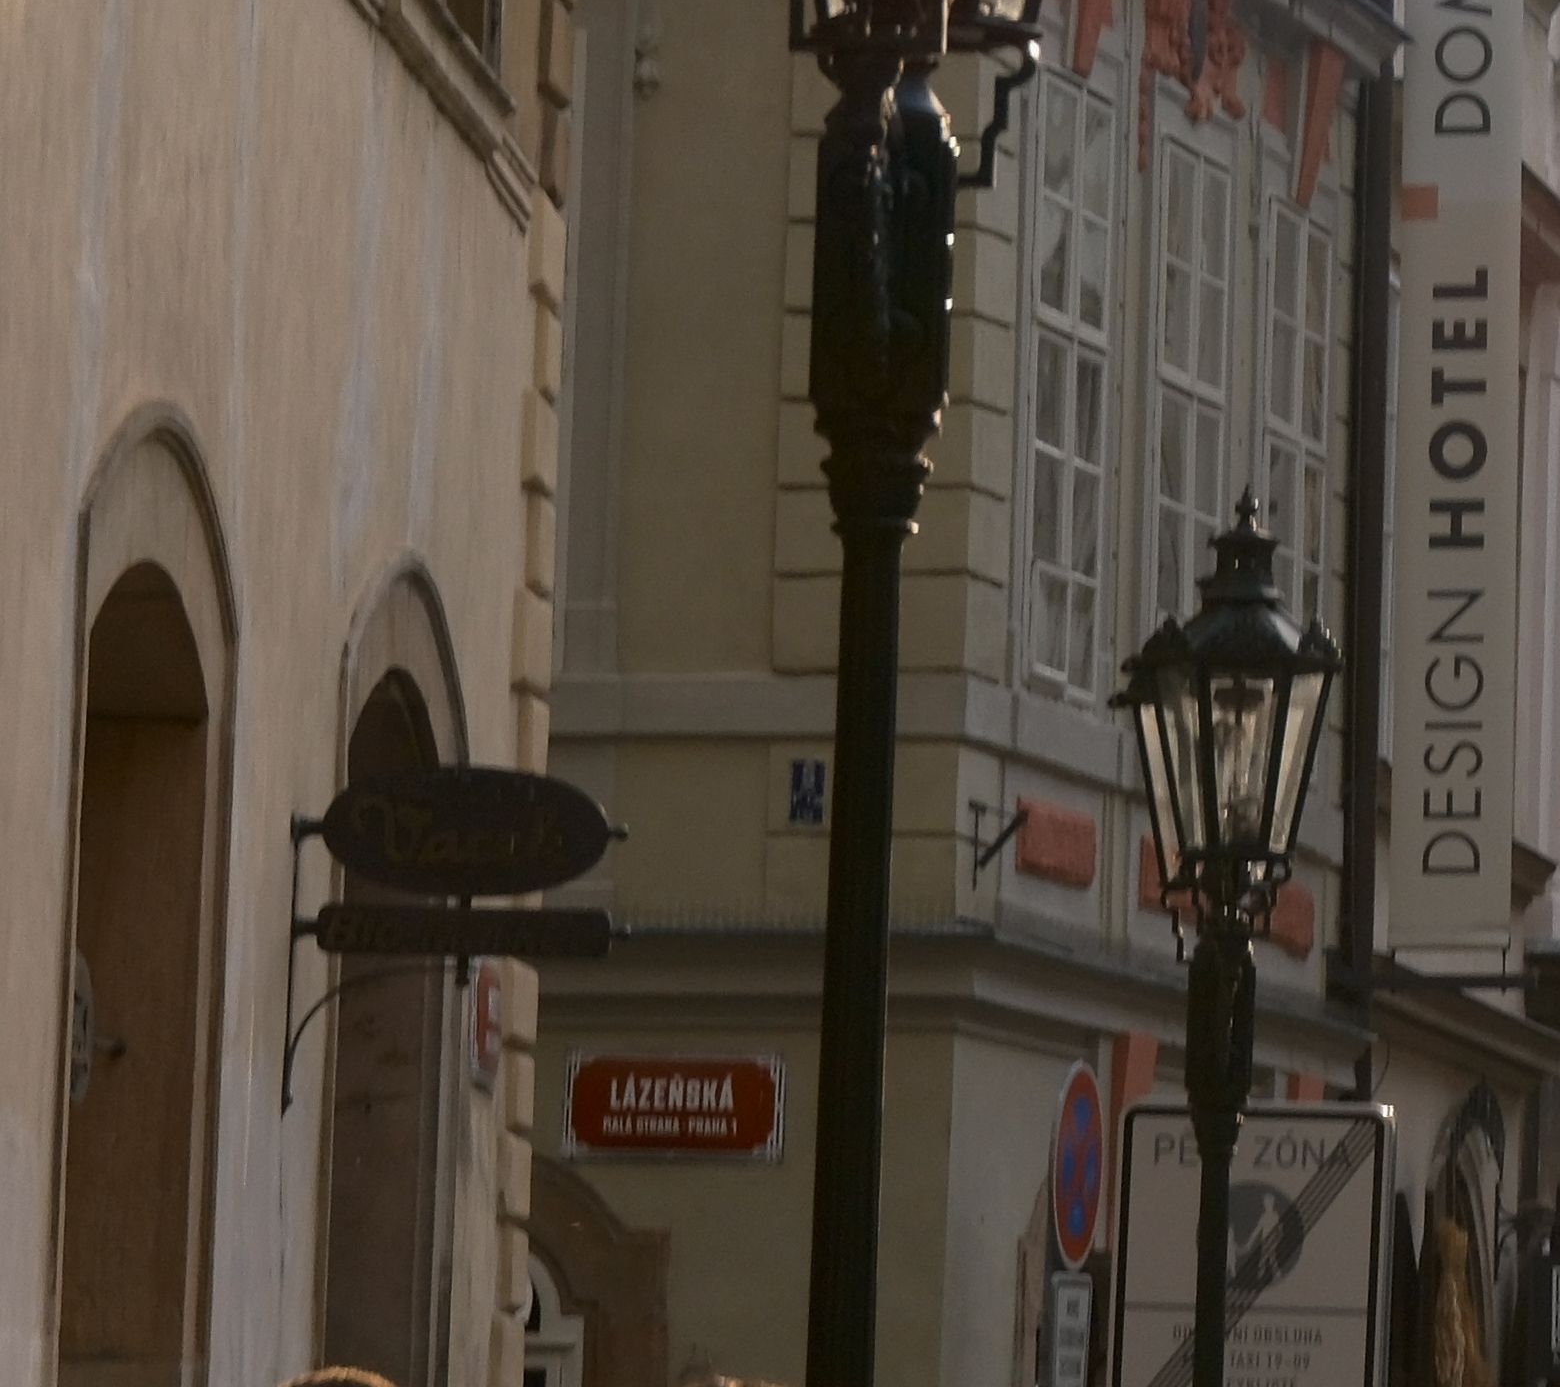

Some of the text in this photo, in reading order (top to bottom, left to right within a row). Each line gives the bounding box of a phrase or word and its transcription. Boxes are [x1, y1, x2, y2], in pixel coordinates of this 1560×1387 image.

[1422, 266, 1489, 876] DESIGN HOTEL
[609, 1071, 734, 1113] LÁZEŇSKÁ
[1252, 1132, 1352, 1168] ZÓNA
